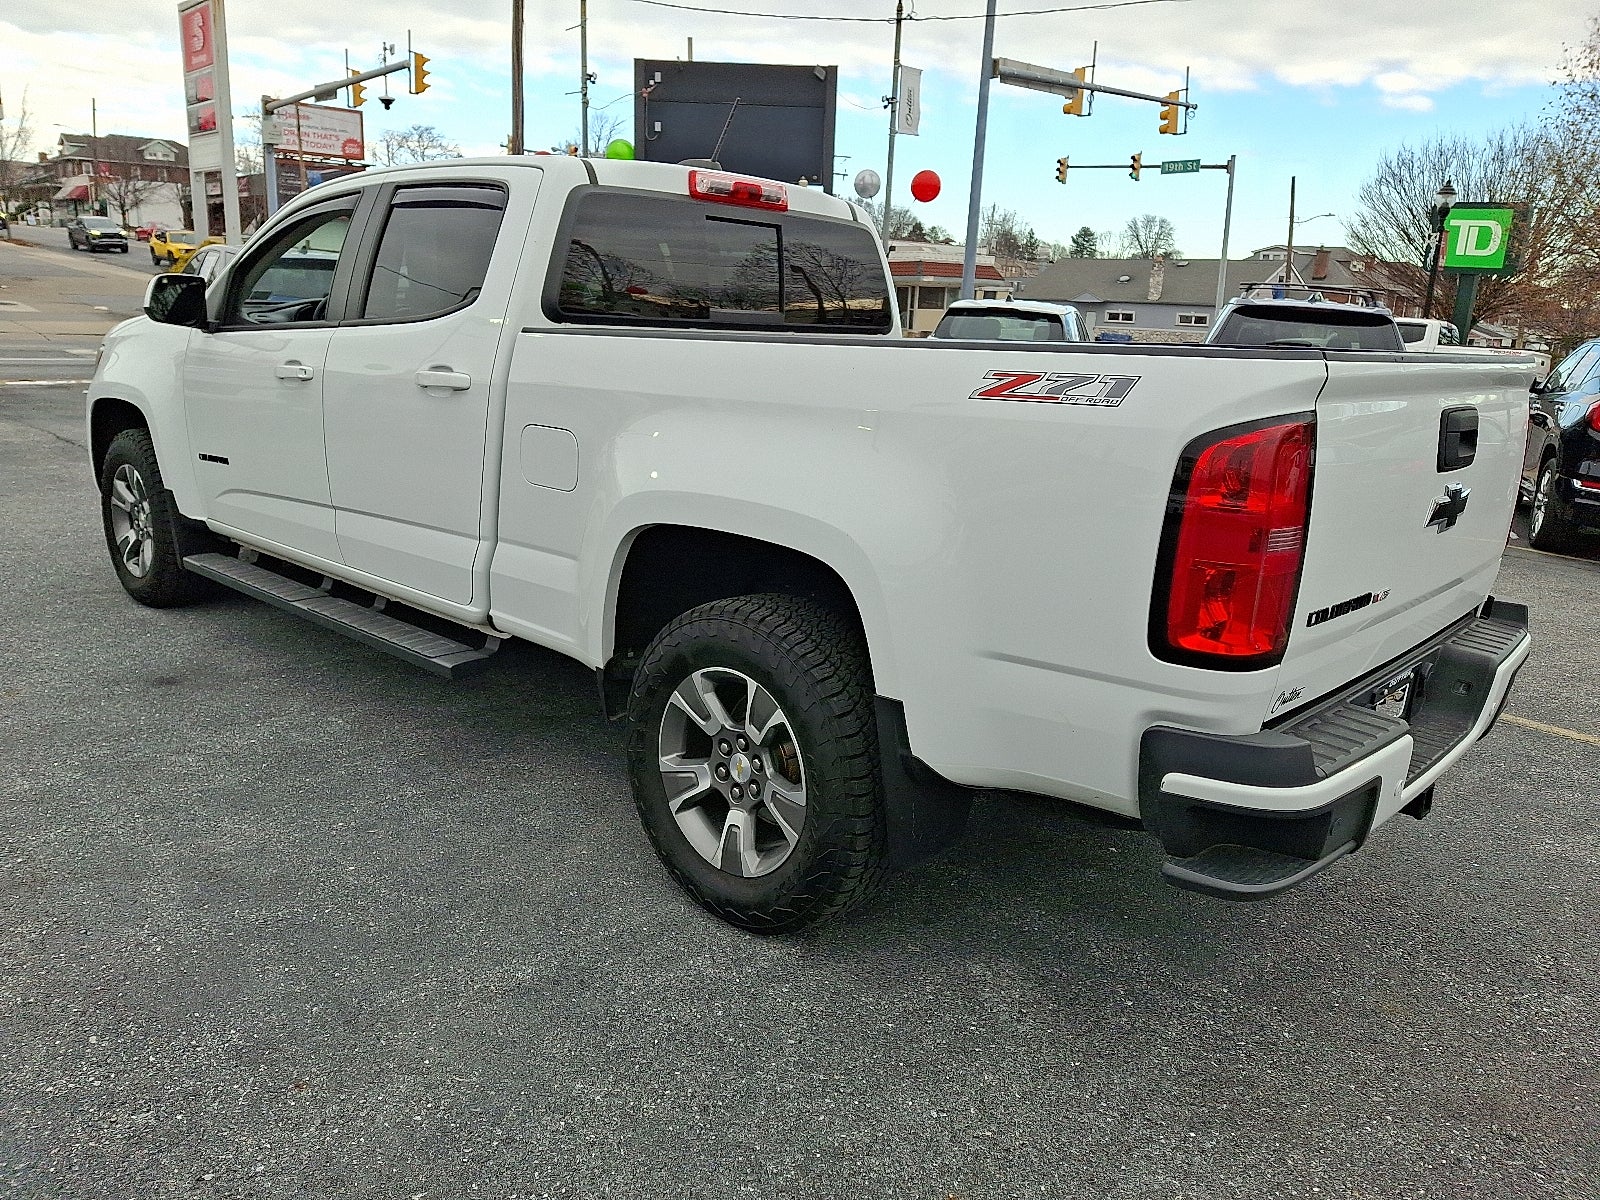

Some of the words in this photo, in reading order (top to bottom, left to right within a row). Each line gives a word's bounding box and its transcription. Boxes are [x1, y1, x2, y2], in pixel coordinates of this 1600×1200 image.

[1165, 163, 1184, 172] 19th
[1186, 161, 1197, 171] St
[1449, 219, 1503, 257] TD
[968, 369, 1142, 407] Z71
